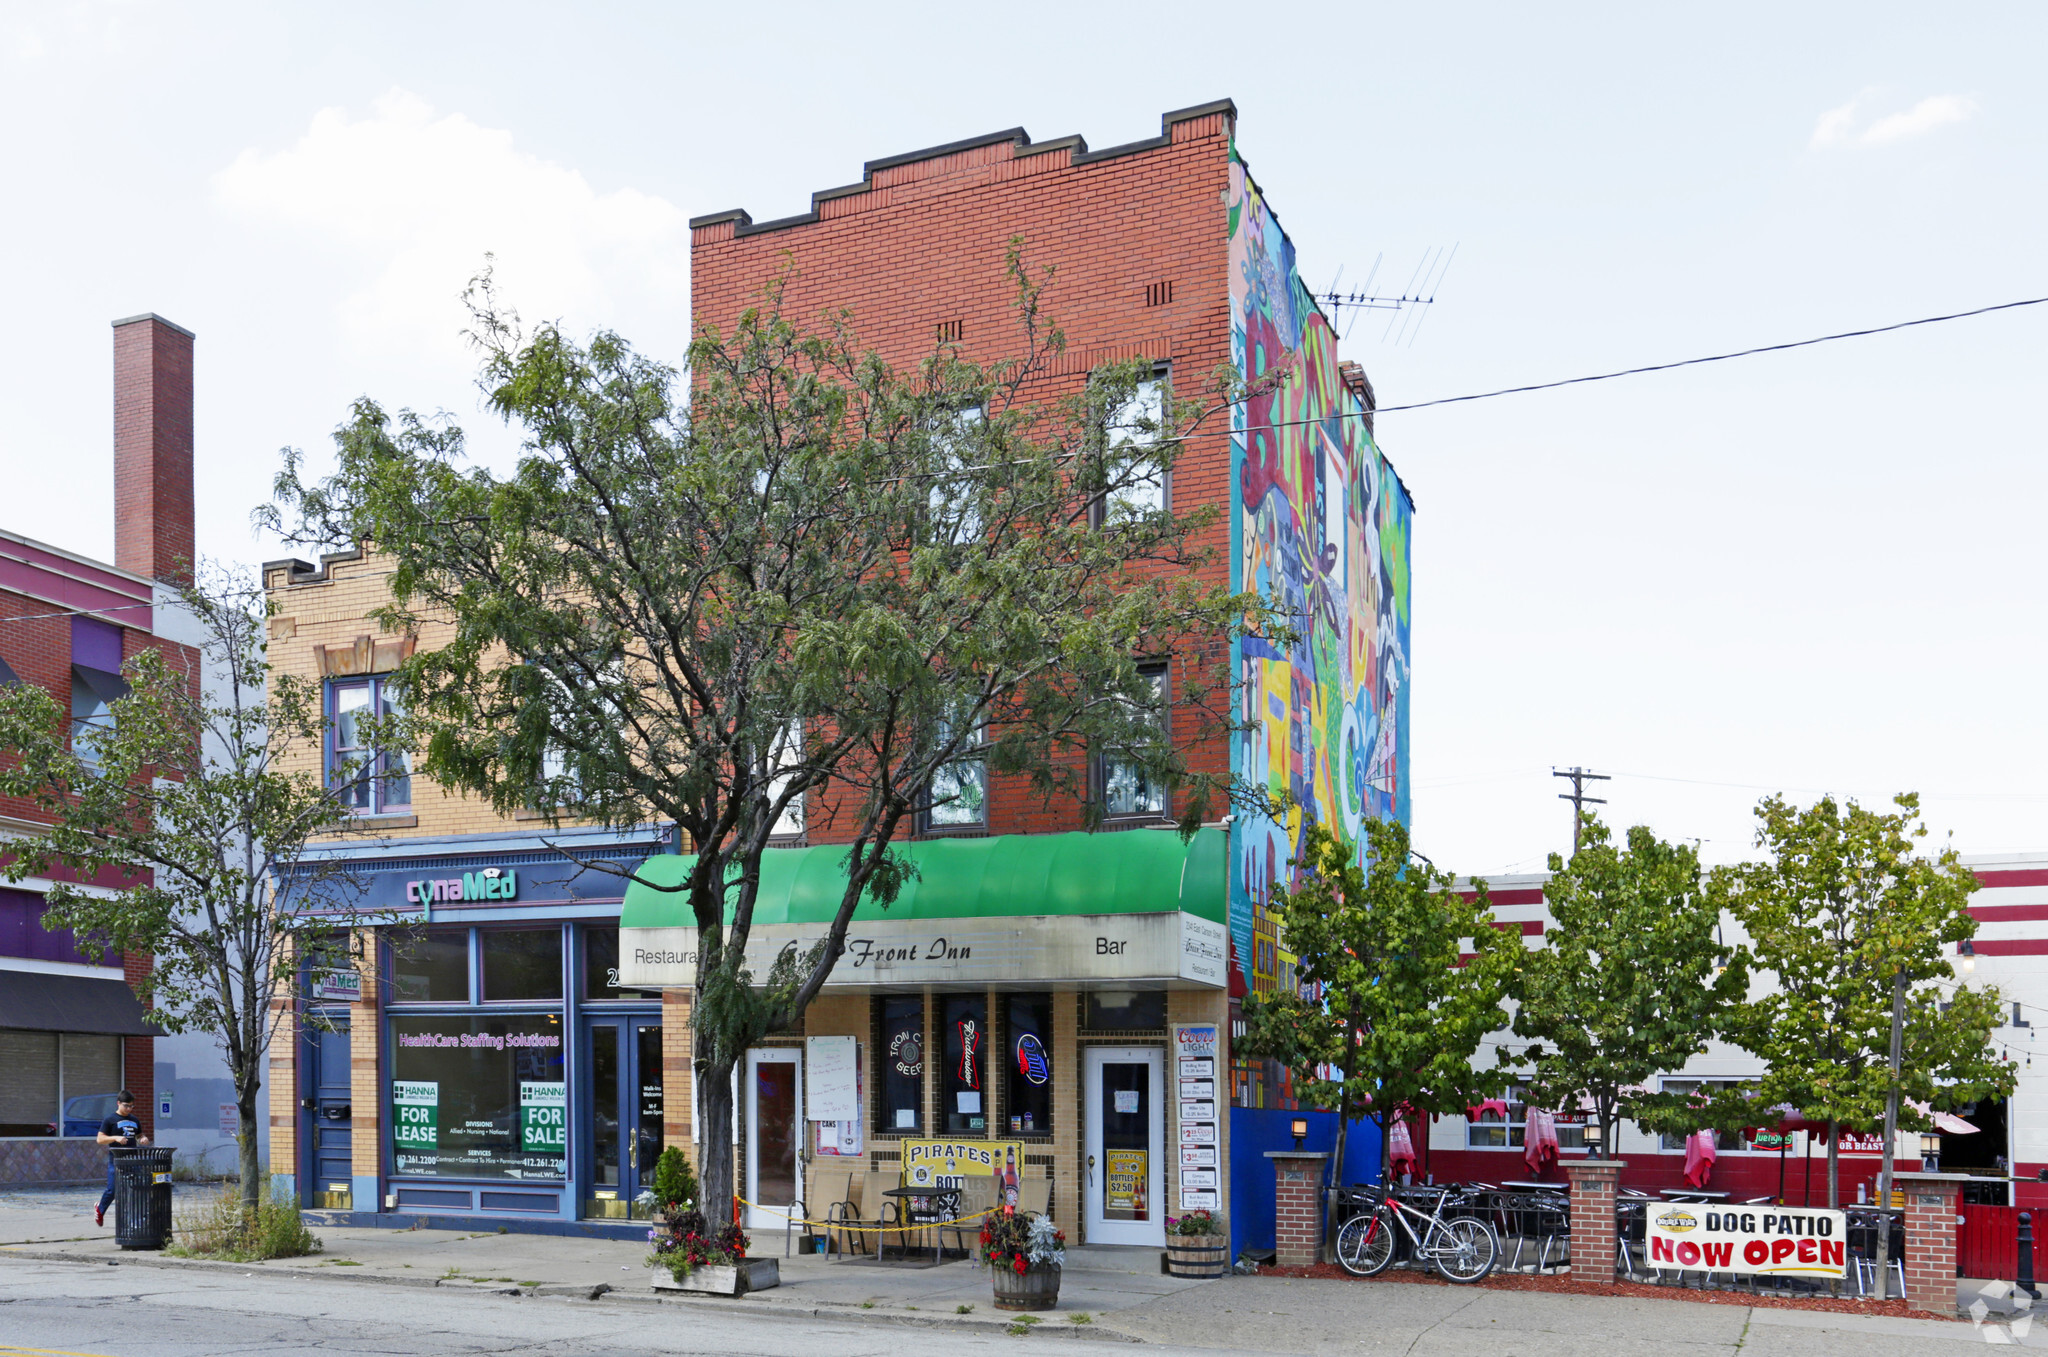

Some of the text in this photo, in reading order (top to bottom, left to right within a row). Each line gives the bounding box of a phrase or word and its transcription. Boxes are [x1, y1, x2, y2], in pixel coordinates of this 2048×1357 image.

[849, 939, 917, 968] Front
[925, 937, 971, 960] Inn
[1096, 937, 1127, 955] Bar
[635, 948, 698, 964] Restaura
[400, 1032, 559, 1050] HealthCare Staffing Solutions
[1178, 1028, 1215, 1043] Coors
[890, 1031, 910, 1057] IRON
[1183, 1043, 1210, 1051] LIGHT
[963, 1020, 975, 1087] Budweiser
[405, 1086, 436, 1095] HANNA
[401, 1107, 429, 1123] FOR
[528, 1108, 562, 1125] FOR
[466, 1128, 485, 1136] Nursing
[822, 1120, 837, 1128] CANS
[394, 1125, 437, 1142] LEASE
[525, 1127, 565, 1144] SALE
[911, 1144, 991, 1165] PIRATES
[1839, 1142, 1884, 1151] OR BEAST
[1111, 1153, 1144, 1161] PIRATES
[1110, 1174, 1134, 1182] BOTTLES
[1111, 1182, 1132, 1192] $2.50
[1706, 1212, 1833, 1237] DOG PATIO
[1651, 1236, 1845, 1268] NOW OPEN
